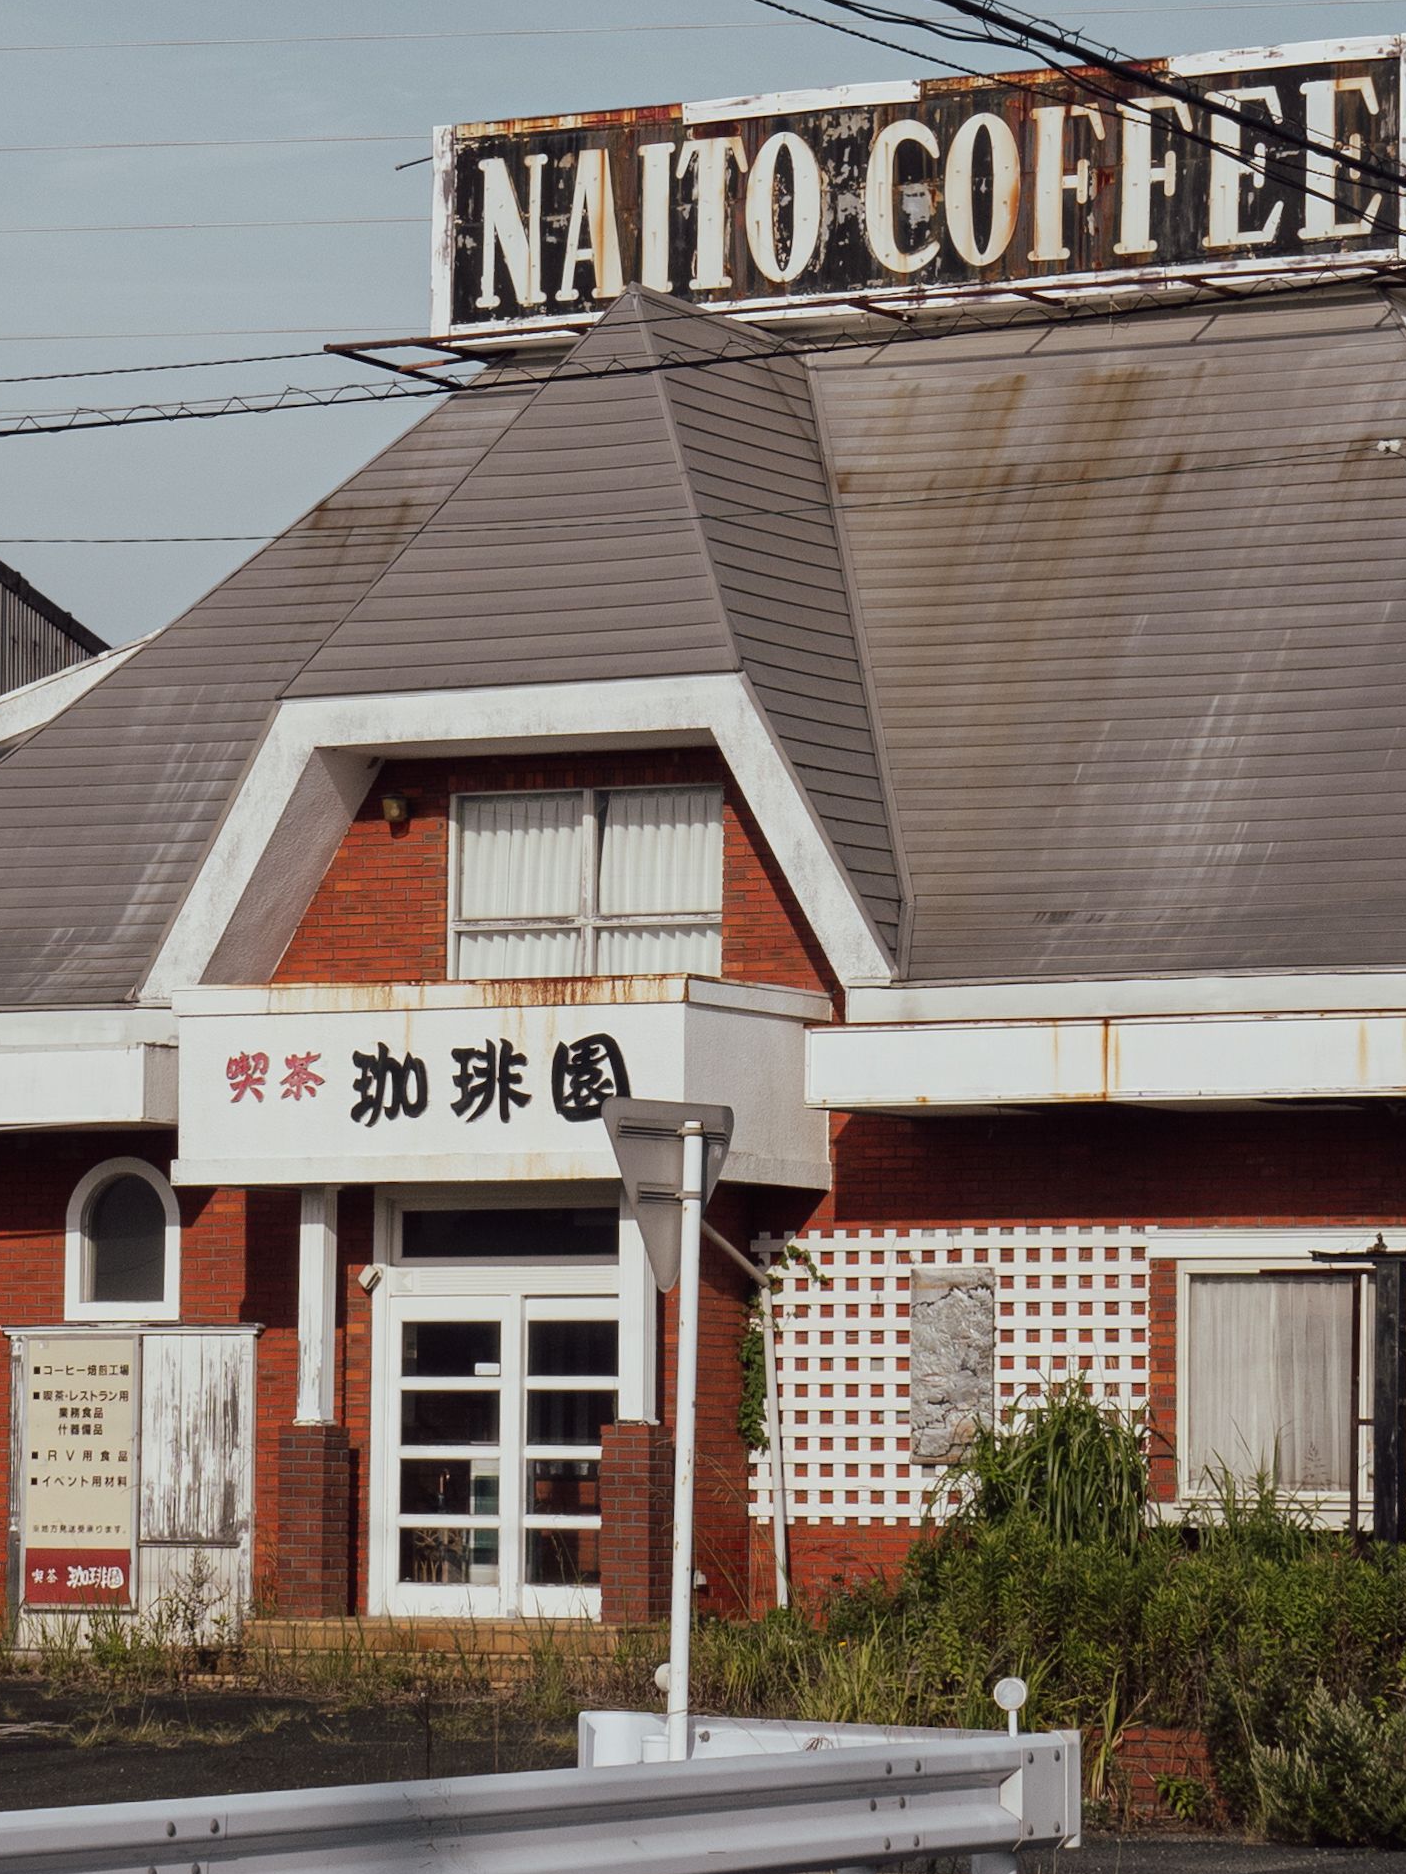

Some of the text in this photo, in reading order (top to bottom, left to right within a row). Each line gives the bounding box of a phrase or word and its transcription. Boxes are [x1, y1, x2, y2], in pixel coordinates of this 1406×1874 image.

[475, 75, 1384, 309] NAITO COFFEE
[226, 1031, 633, 1128] 喫茶 珈琲園
